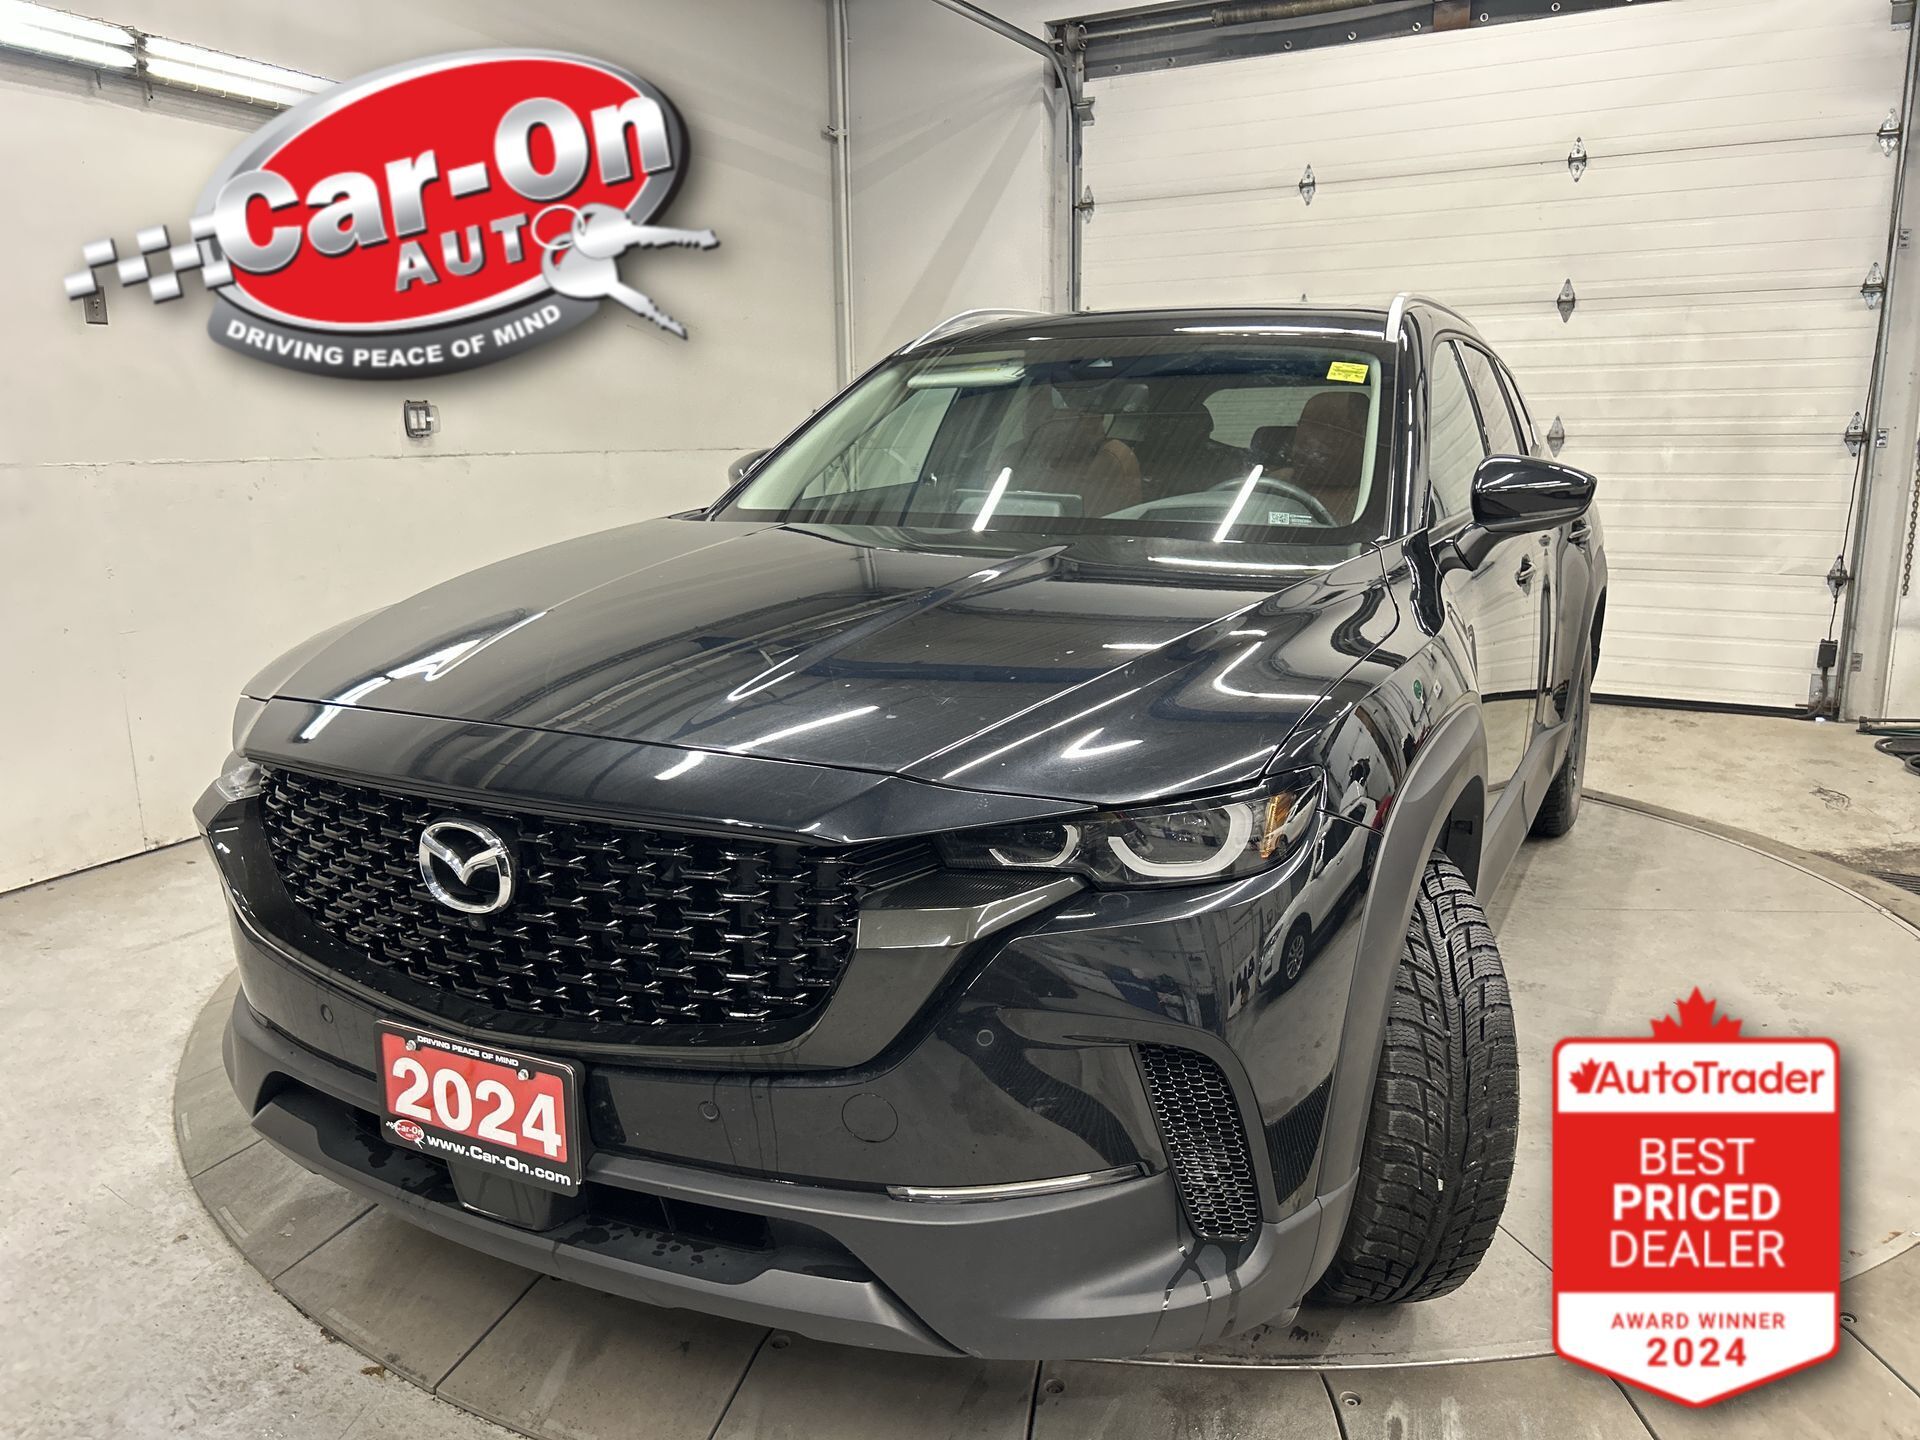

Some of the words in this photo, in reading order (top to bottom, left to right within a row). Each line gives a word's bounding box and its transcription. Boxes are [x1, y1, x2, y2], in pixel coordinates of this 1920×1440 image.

[417, 1035, 451, 1050] DRIVING
[452, 1045, 480, 1058] PEACE
[481, 1052, 494, 1061] OF
[495, 1055, 519, 1067] MIND
[393, 1058, 562, 1157] 2024
[396, 1122, 423, 1136] Car-On
[427, 1135, 572, 1186] www.Car-On.com
